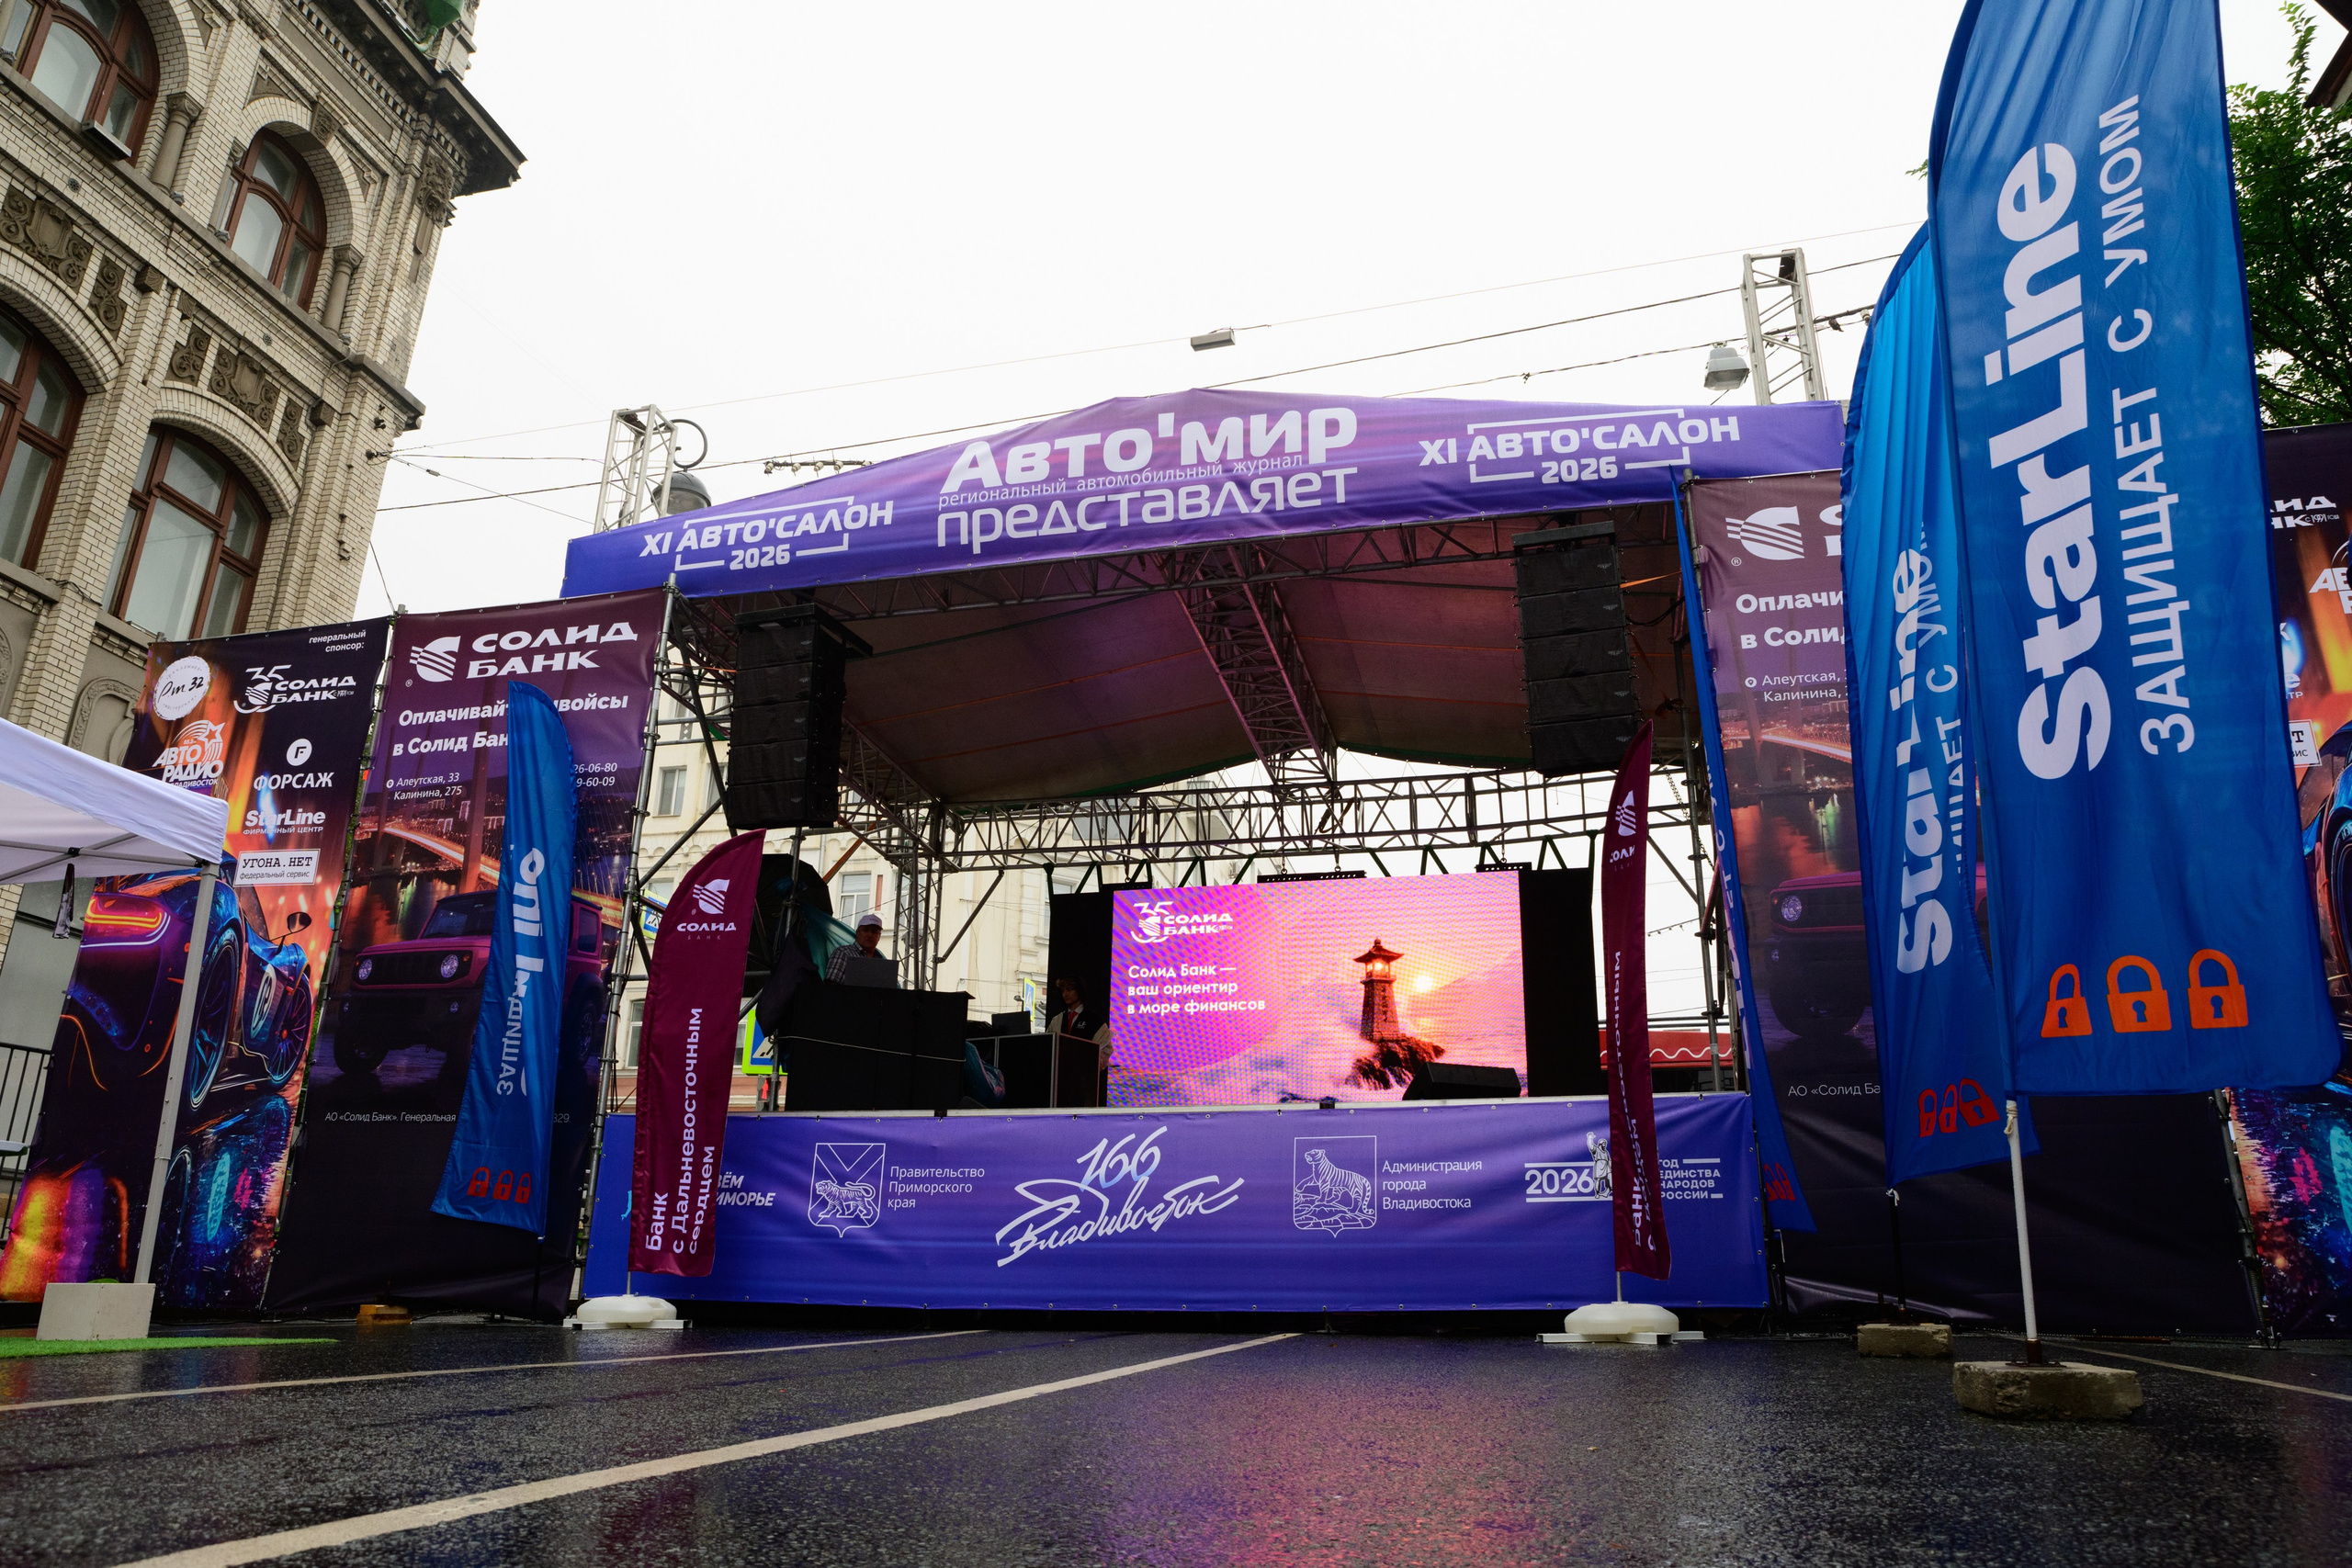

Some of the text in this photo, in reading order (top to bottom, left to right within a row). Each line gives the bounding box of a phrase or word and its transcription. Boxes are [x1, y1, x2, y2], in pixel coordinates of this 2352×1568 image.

[2098, 94, 2195, 755] ЗАЩИЩАЕТ С УМОМ
[1419, 438, 1457, 467] XI
[1984, 142, 2111, 780] StarLine
[1541, 455, 1618, 484] 2026
[938, 455, 1304, 511] региональный автомобильный журнал
[936, 467, 1358, 555] представляет
[639, 532, 673, 558] XI
[729, 544, 790, 570] 2026
[309, 629, 367, 644] генеральный
[471, 622, 638, 653] СОЛИД
[1740, 626, 1845, 649] в Соли
[325, 642, 365, 652] спонсор:
[466, 649, 600, 679] БАНК
[187, 676, 204, 692] 32
[276, 676, 356, 691] СОЛИД
[1762, 671, 1840, 686] Алеутская,
[1926, 664, 1958, 693] С
[271, 690, 337, 704] БАНК
[1763, 688, 1842, 703] Калинина,
[399, 694, 628, 727] Оплачивай войсы
[392, 731, 508, 756] в Солид Бан
[152, 744, 202, 768] АВТО
[162, 760, 223, 783] РАДИО
[573, 762, 617, 774] 26-06-80
[171, 778, 219, 788] ЛАДИВОСТОК
[254, 772, 334, 791] ФОРСАЖ
[396, 772, 459, 788] Алеутская, 33
[576, 776, 616, 788] 9-60-09
[393, 785, 462, 800] Калинина, 275
[245, 808, 325, 827] StarLine
[239, 870, 310, 880] федеральный сервис
[1163, 913, 1233, 924] СОЛИД
[676, 922, 737, 932] СОЛИД
[1163, 924, 1219, 935] БАНК
[1128, 964, 1177, 978] Солид
[1181, 964, 1217, 976] Банк
[1127, 982, 1238, 998] ваш ориентир
[1127, 998, 1266, 1016] в море финансов
[1788, 1082, 1881, 1097] АО «Солид Ба
[324, 1112, 338, 1122] АО
[400, 1111, 456, 1123] Генеральная
[672, 1008, 703, 1254] с Дальневосточным
[1076, 1125, 1168, 1192] 166
[889, 1166, 986, 1179] Правительство
[1382, 1160, 1482, 1174] Администрация
[888, 1180, 973, 1196] Приморского
[1382, 1178, 1427, 1193] города
[1524, 1168, 1594, 1195] 2026
[689, 1146, 715, 1255] сердцем
[715, 1191, 776, 1207] ИМОРЬЕ
[888, 1198, 916, 1210] края
[1382, 1196, 1472, 1211] Владивостока
[645, 1191, 669, 1250] Банк
[995, 1174, 1245, 1268] Владивосток
